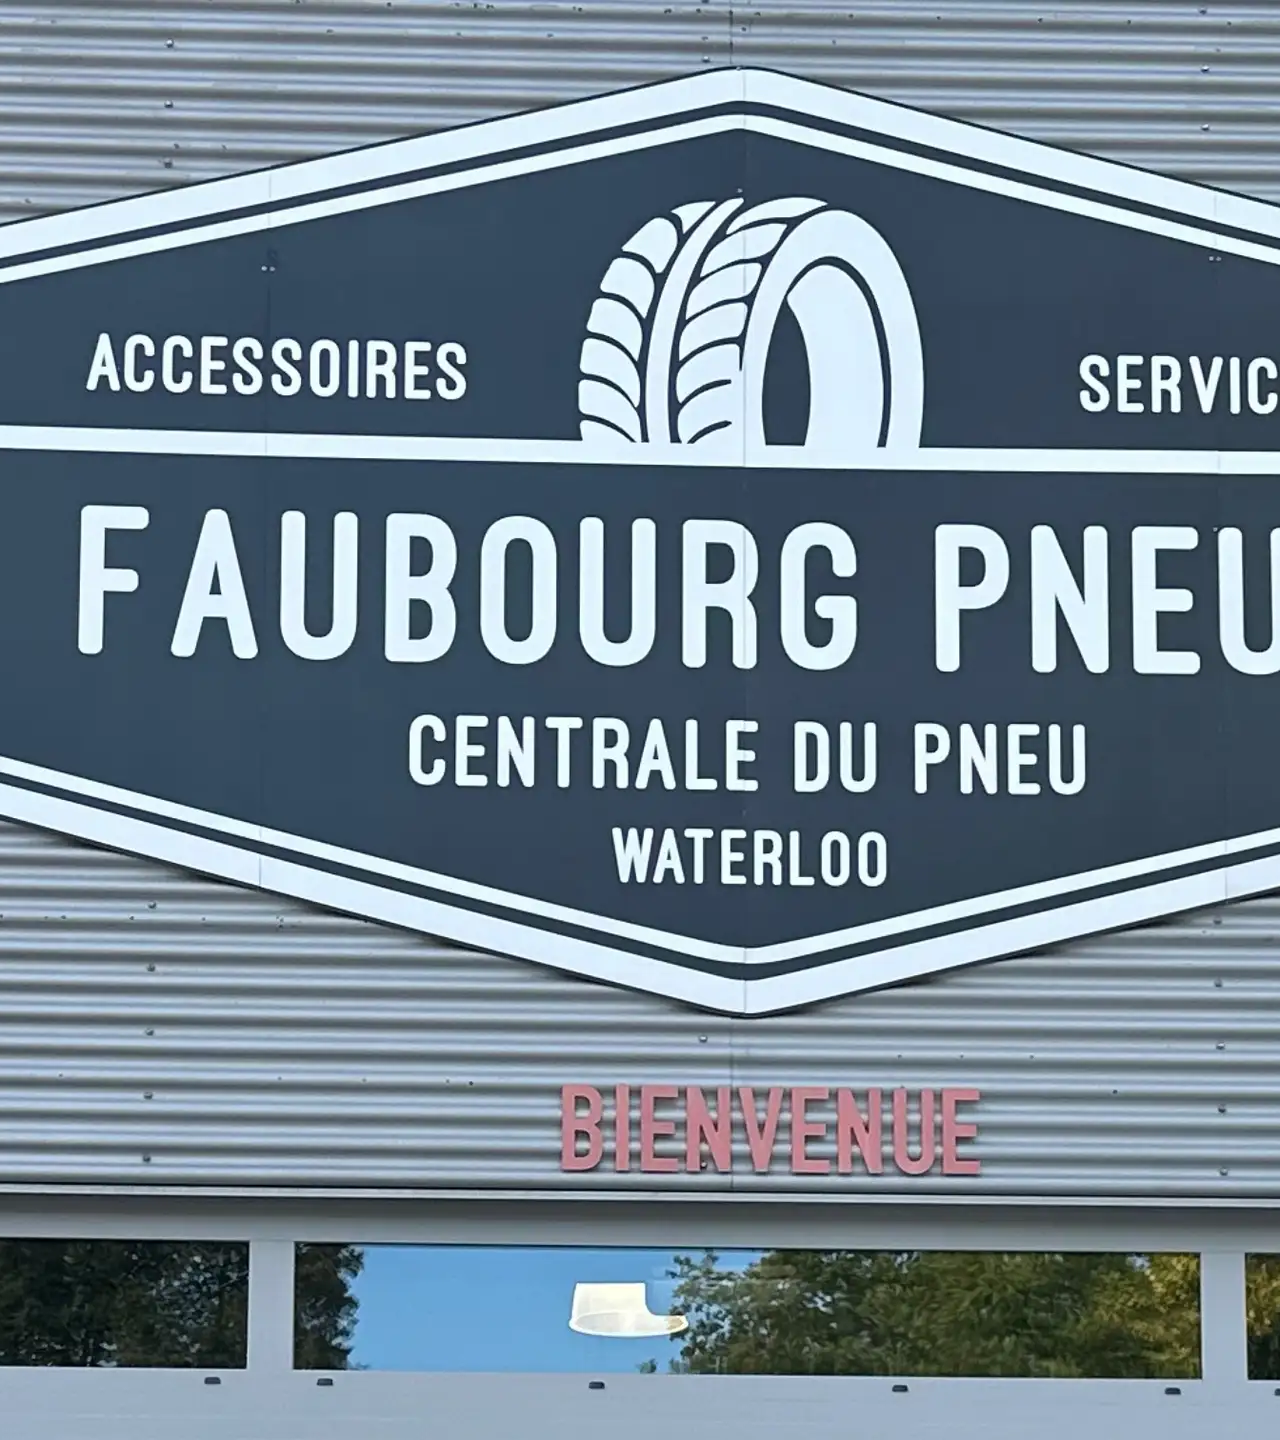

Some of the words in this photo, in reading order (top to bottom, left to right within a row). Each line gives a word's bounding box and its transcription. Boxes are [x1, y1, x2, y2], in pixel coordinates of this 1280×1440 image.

[85, 332, 467, 401] ACCESSOIRES
[77, 504, 858, 671] FAUBOURG
[408, 713, 760, 793] CENTRALE
[793, 720, 878, 794] DU
[913, 722, 1087, 796] PNEU
[610, 826, 888, 888] WATERLOO
[559, 1082, 982, 1175] BIENVENUE
